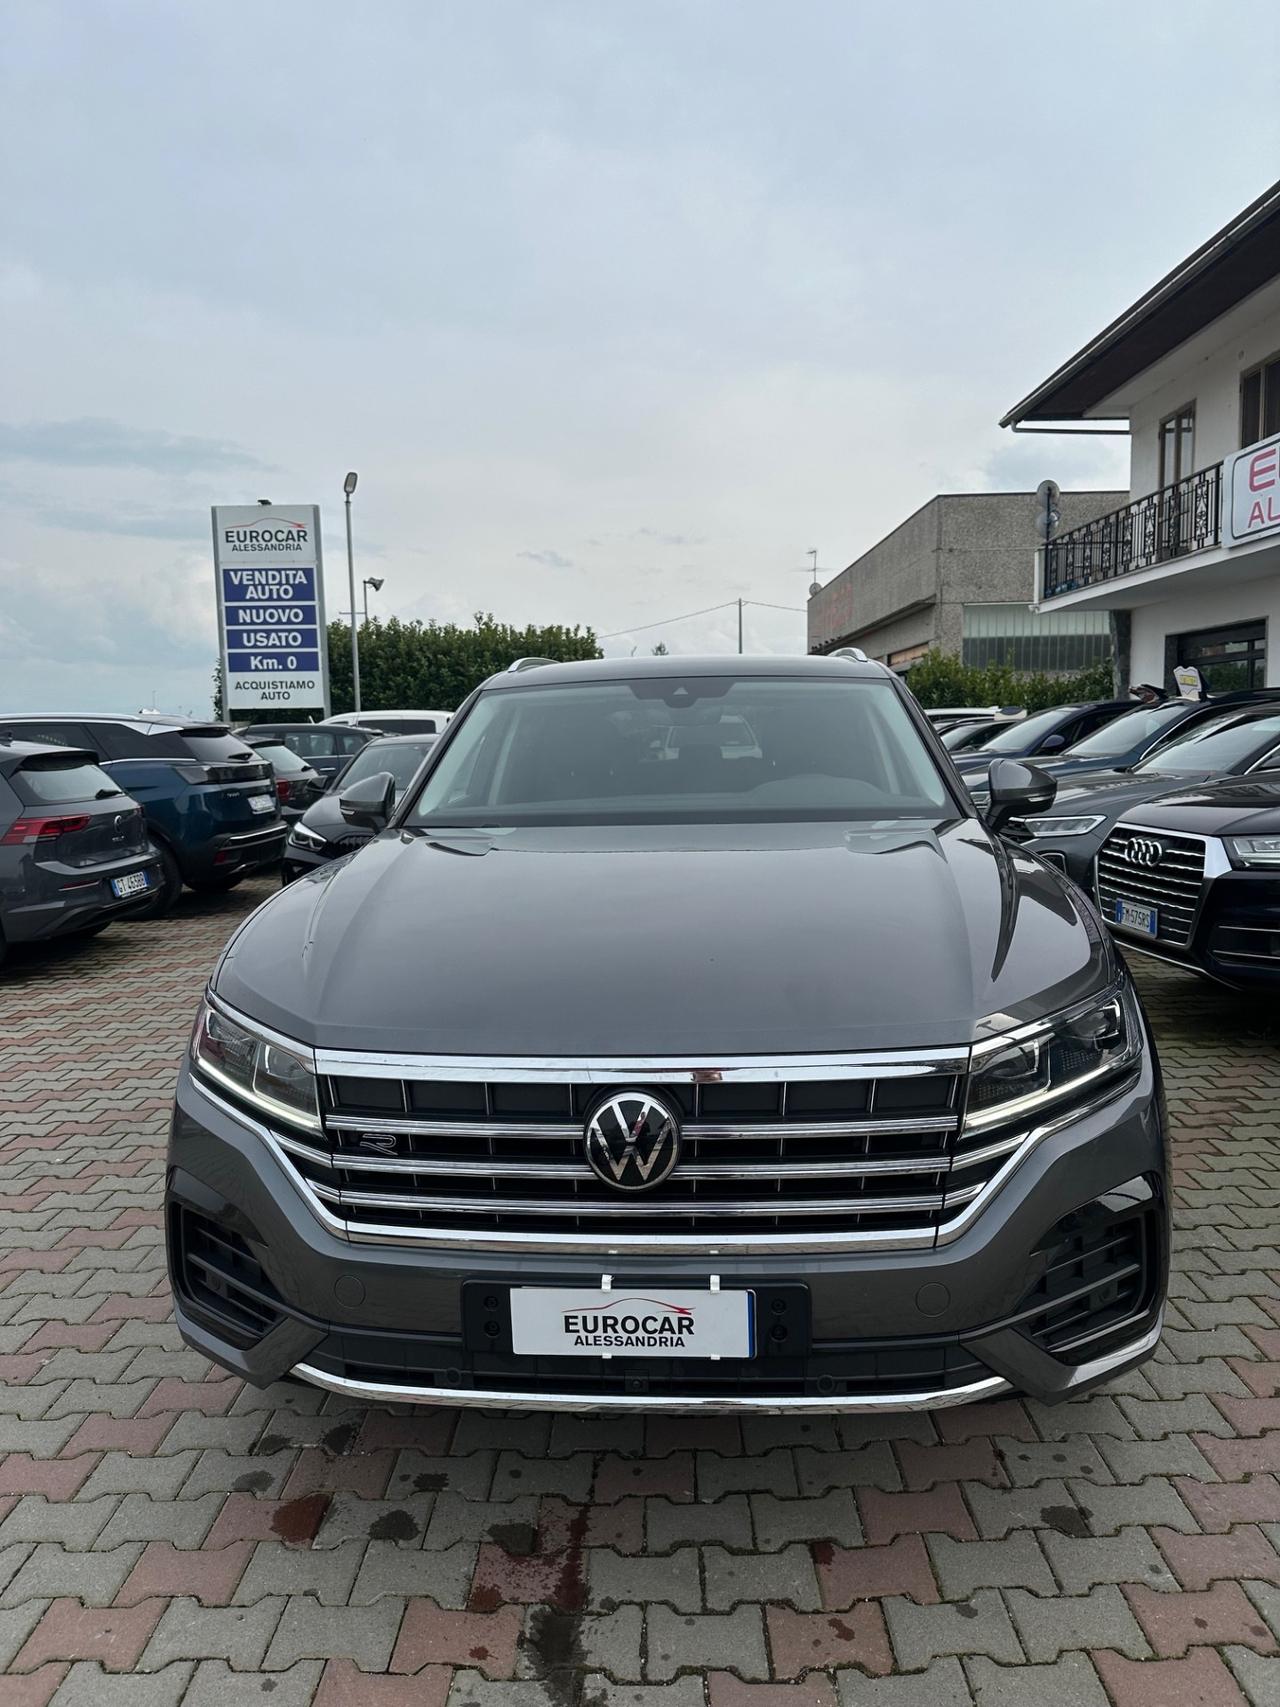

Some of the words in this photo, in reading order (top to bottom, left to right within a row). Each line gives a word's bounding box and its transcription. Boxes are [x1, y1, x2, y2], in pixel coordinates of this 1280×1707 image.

[225, 529, 308, 543] EUROCAR
[231, 543, 303, 552] ALESSANDRIA
[230, 570, 307, 585] VENDITA
[245, 585, 294, 599] AUTO
[238, 608, 304, 624] NUOVO
[242, 631, 302, 647] USATO
[250, 655, 283, 670] Km.
[287, 655, 297, 670] 0
[234, 680, 315, 690] ACQUISTIAMO
[260, 691, 291, 701] AUTO
[564, 1315, 695, 1335] EUROCAR
[574, 1335, 686, 1348] ALESSANDRIA
